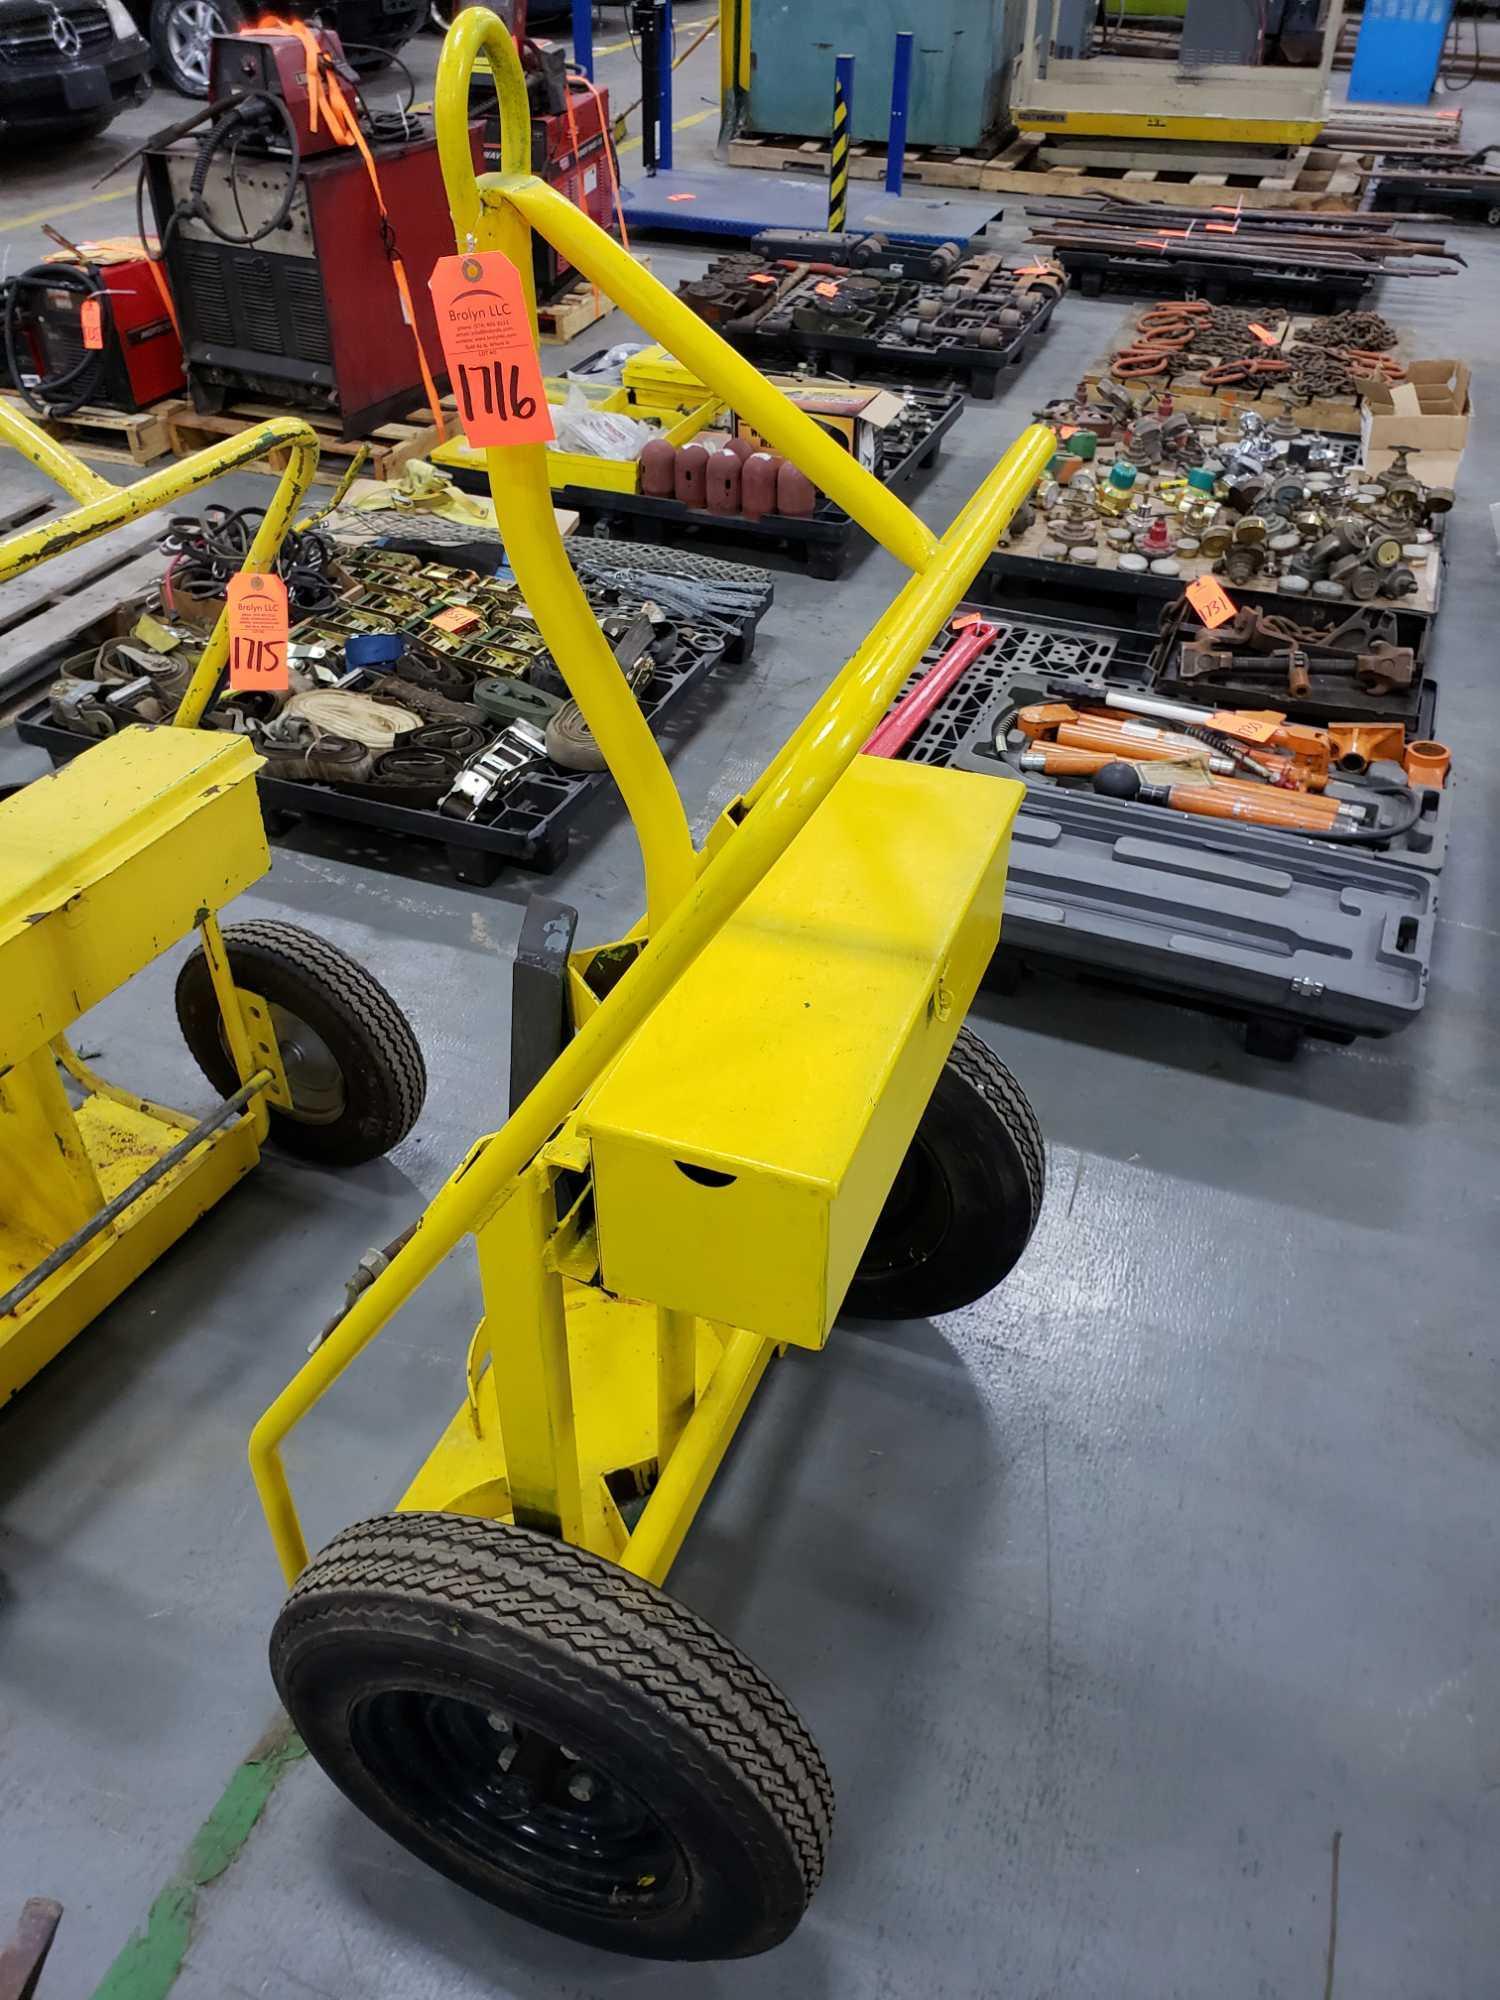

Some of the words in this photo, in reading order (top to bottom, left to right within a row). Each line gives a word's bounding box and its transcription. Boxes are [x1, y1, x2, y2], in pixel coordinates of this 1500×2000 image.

[448, 307, 486, 322] Brolyn
[489, 303, 511, 317] LLC
[458, 361, 536, 422] 1716
[235, 637, 286, 672] 1715
